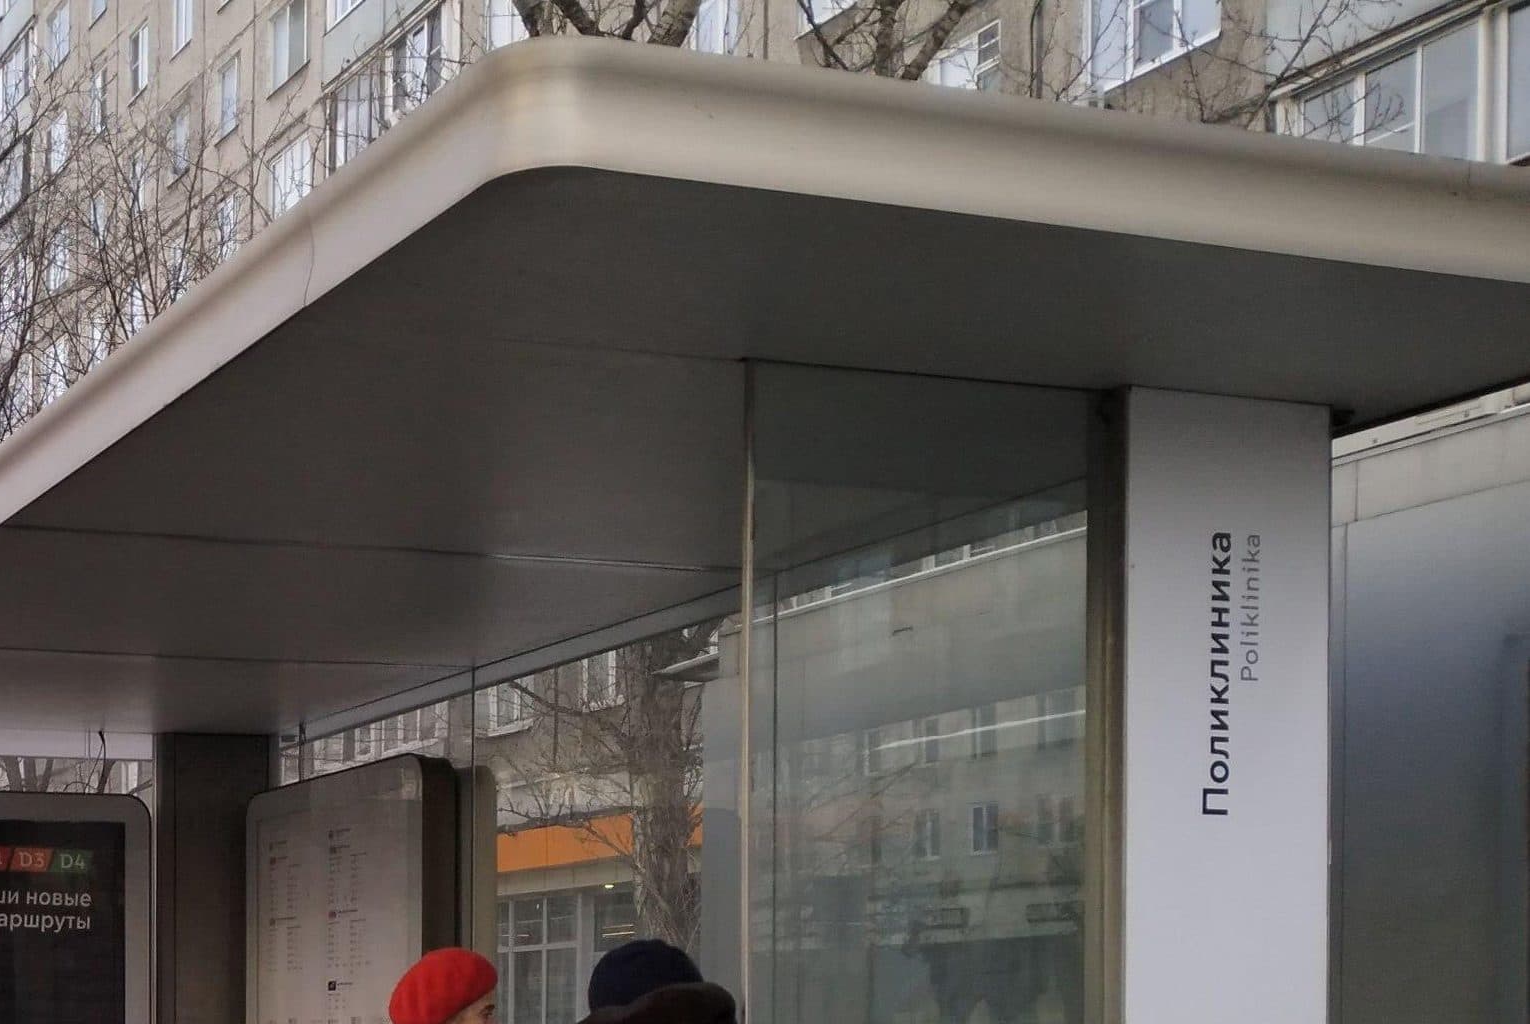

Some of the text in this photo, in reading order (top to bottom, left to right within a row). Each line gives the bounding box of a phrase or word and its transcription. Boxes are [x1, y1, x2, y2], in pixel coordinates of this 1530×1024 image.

[1241, 534, 1261, 681] Poliklinika
[1202, 532, 1231, 815] Поликлиника
[20, 852, 44, 867] D3
[60, 853, 85, 869] D4
[26, 891, 92, 907] новые
